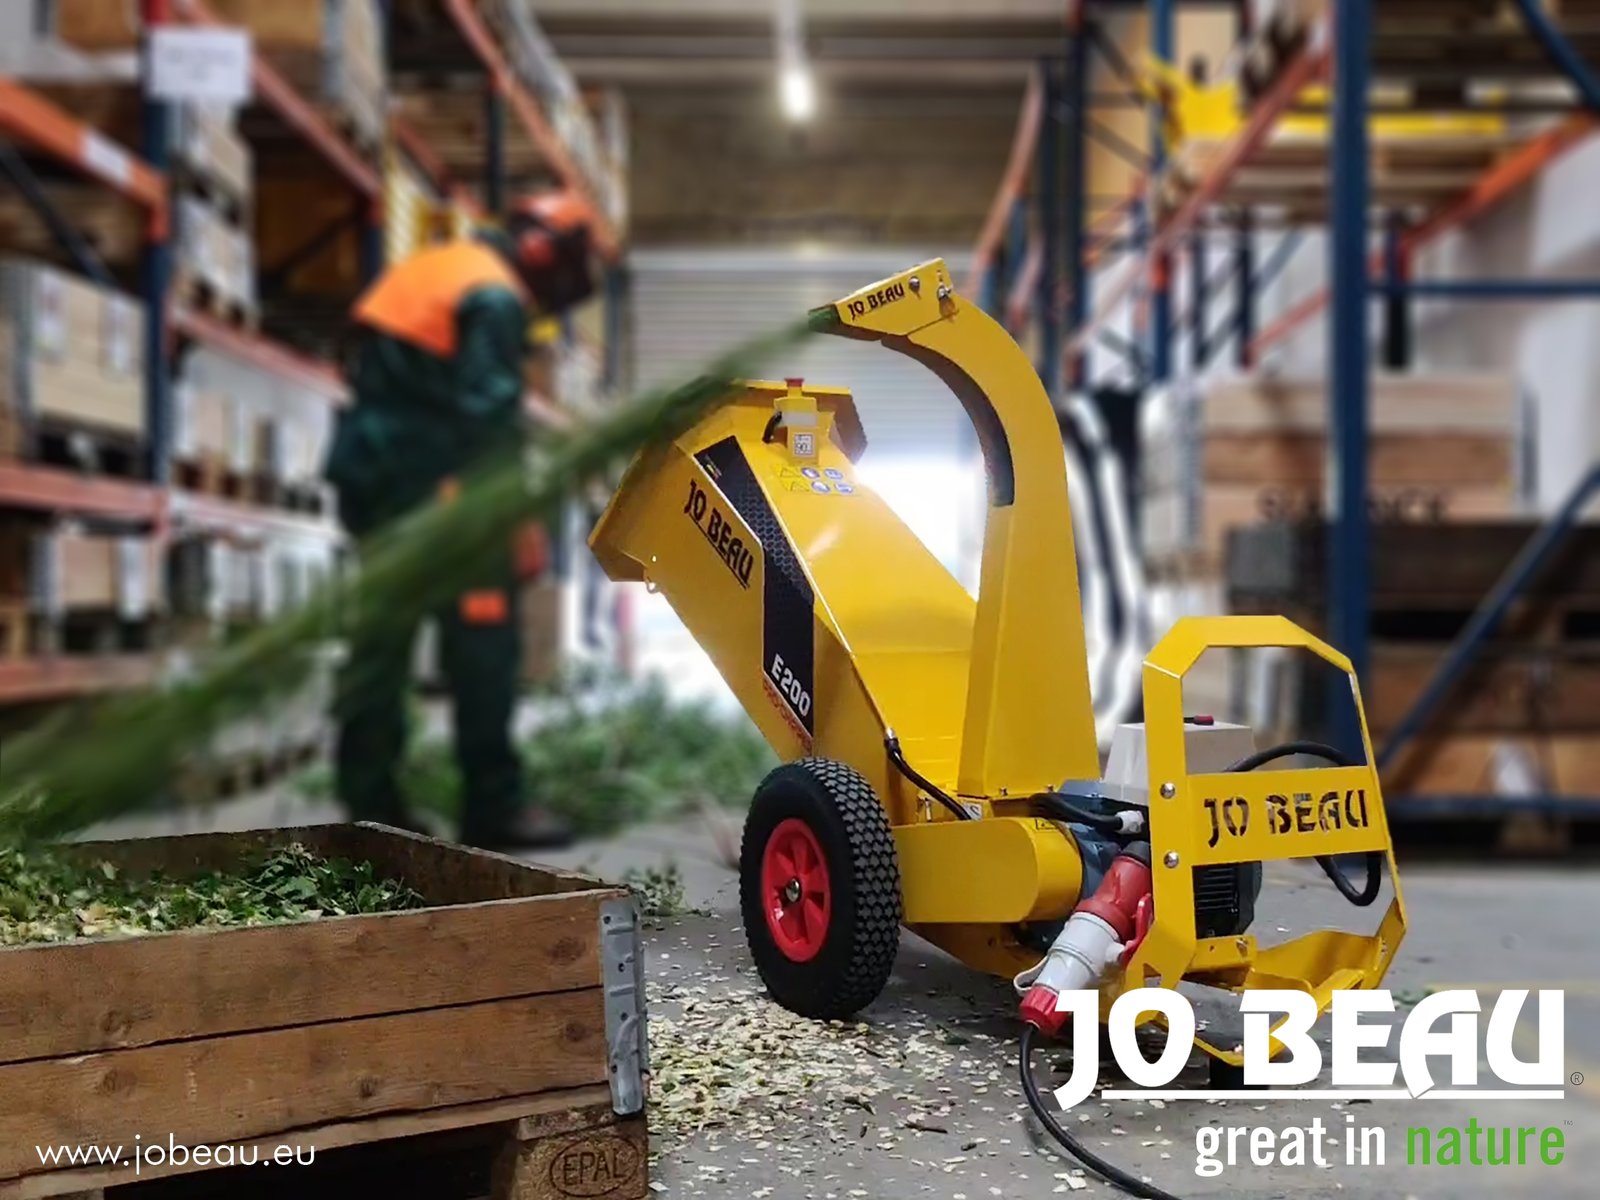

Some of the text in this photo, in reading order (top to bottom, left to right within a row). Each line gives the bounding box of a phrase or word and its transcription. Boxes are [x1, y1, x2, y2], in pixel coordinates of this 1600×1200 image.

[847, 282, 905, 322] JO BEAU
[684, 477, 707, 522] JO
[707, 507, 754, 585] BEAU
[771, 653, 811, 717] E200
[1203, 789, 1369, 848] JO BEAU
[562, 1147, 628, 1186] EPAL
